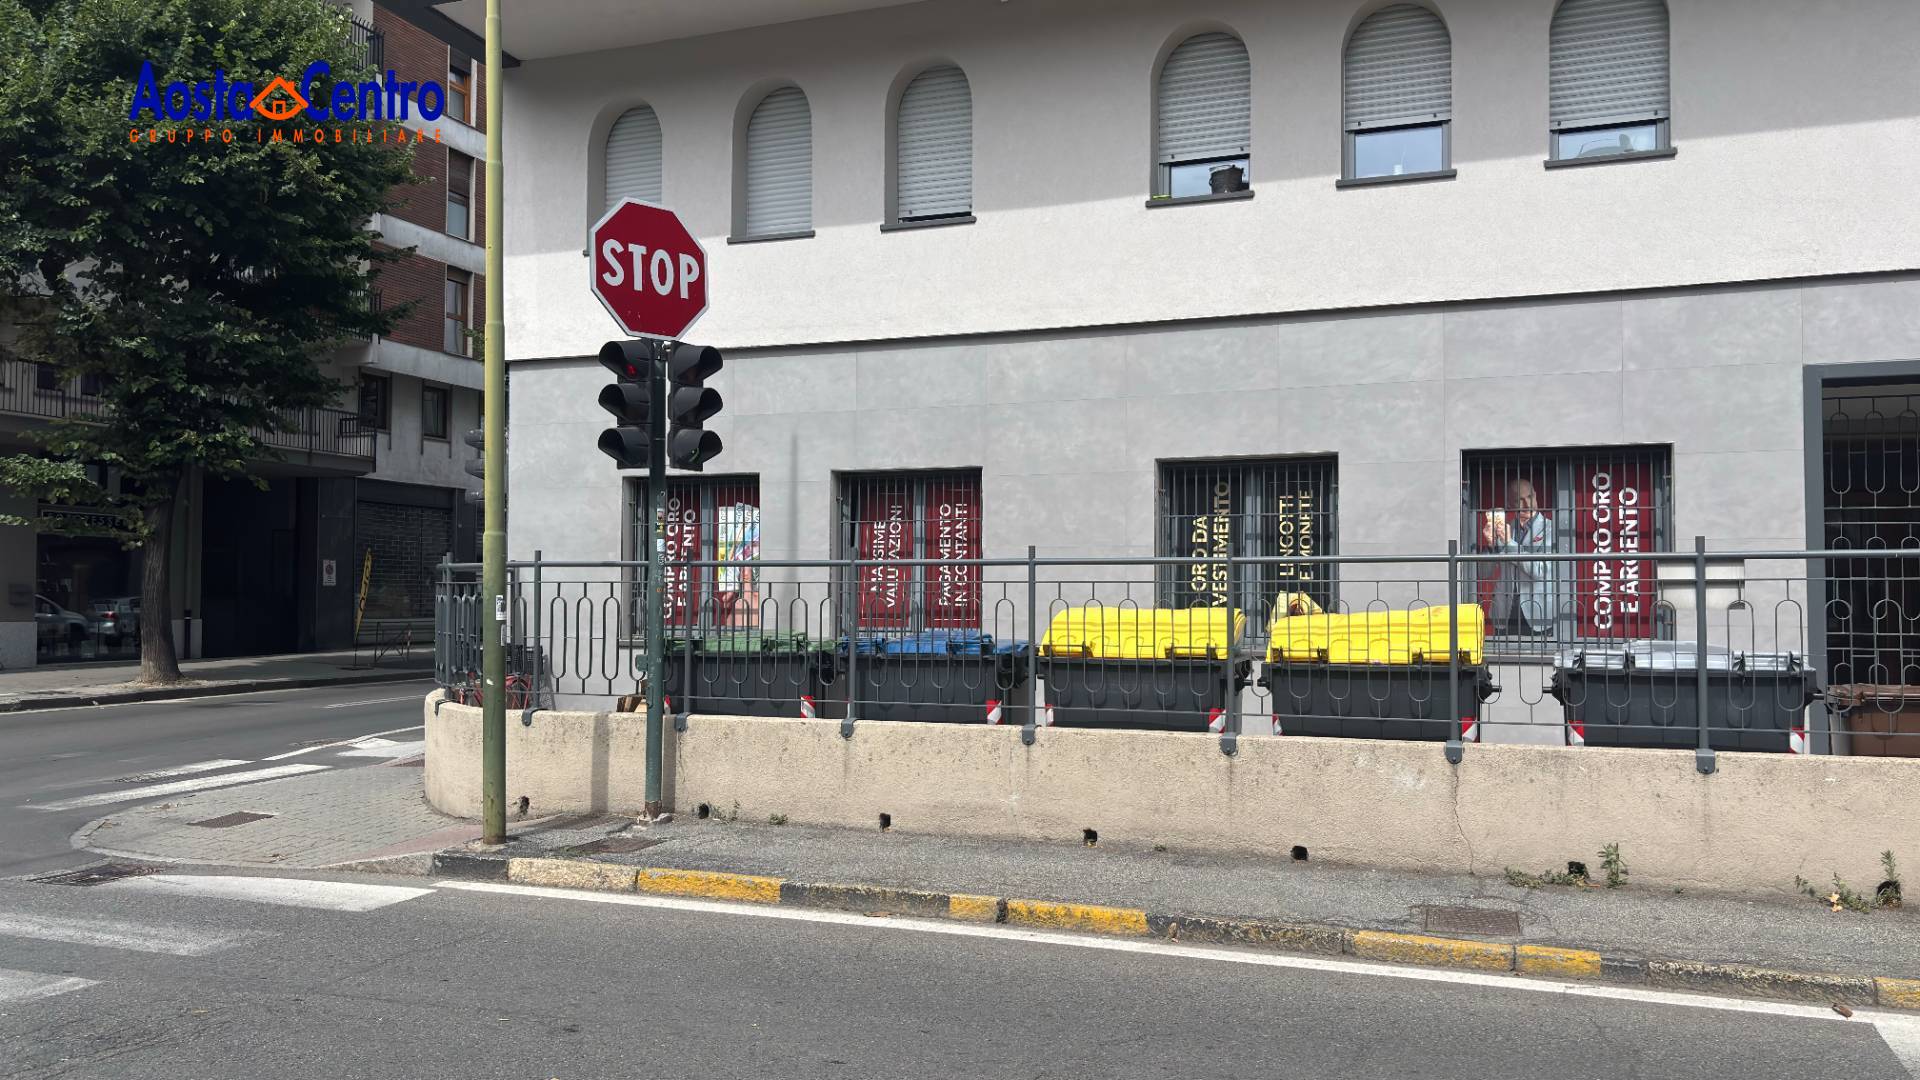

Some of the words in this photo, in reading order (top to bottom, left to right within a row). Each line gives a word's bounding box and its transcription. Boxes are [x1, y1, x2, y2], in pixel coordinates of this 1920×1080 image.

[602, 238, 700, 300] STOP
[667, 498, 680, 536] ORO
[1191, 516, 1208, 543] DA
[1299, 490, 1314, 566] MONETE
[1592, 472, 1611, 523] ORO
[871, 521, 886, 592] MASIME
[886, 505, 903, 608] VALUAZIONI
[939, 504, 952, 606] PAGAMENTO
[954, 503, 968, 587] CONTANTI
[1279, 495, 1294, 577] LINGOTTI
[954, 591, 968, 607] IN
[1191, 547, 1208, 592] ORO
[1592, 528, 1612, 630] COMPRO
[1620, 600, 1638, 614] E
